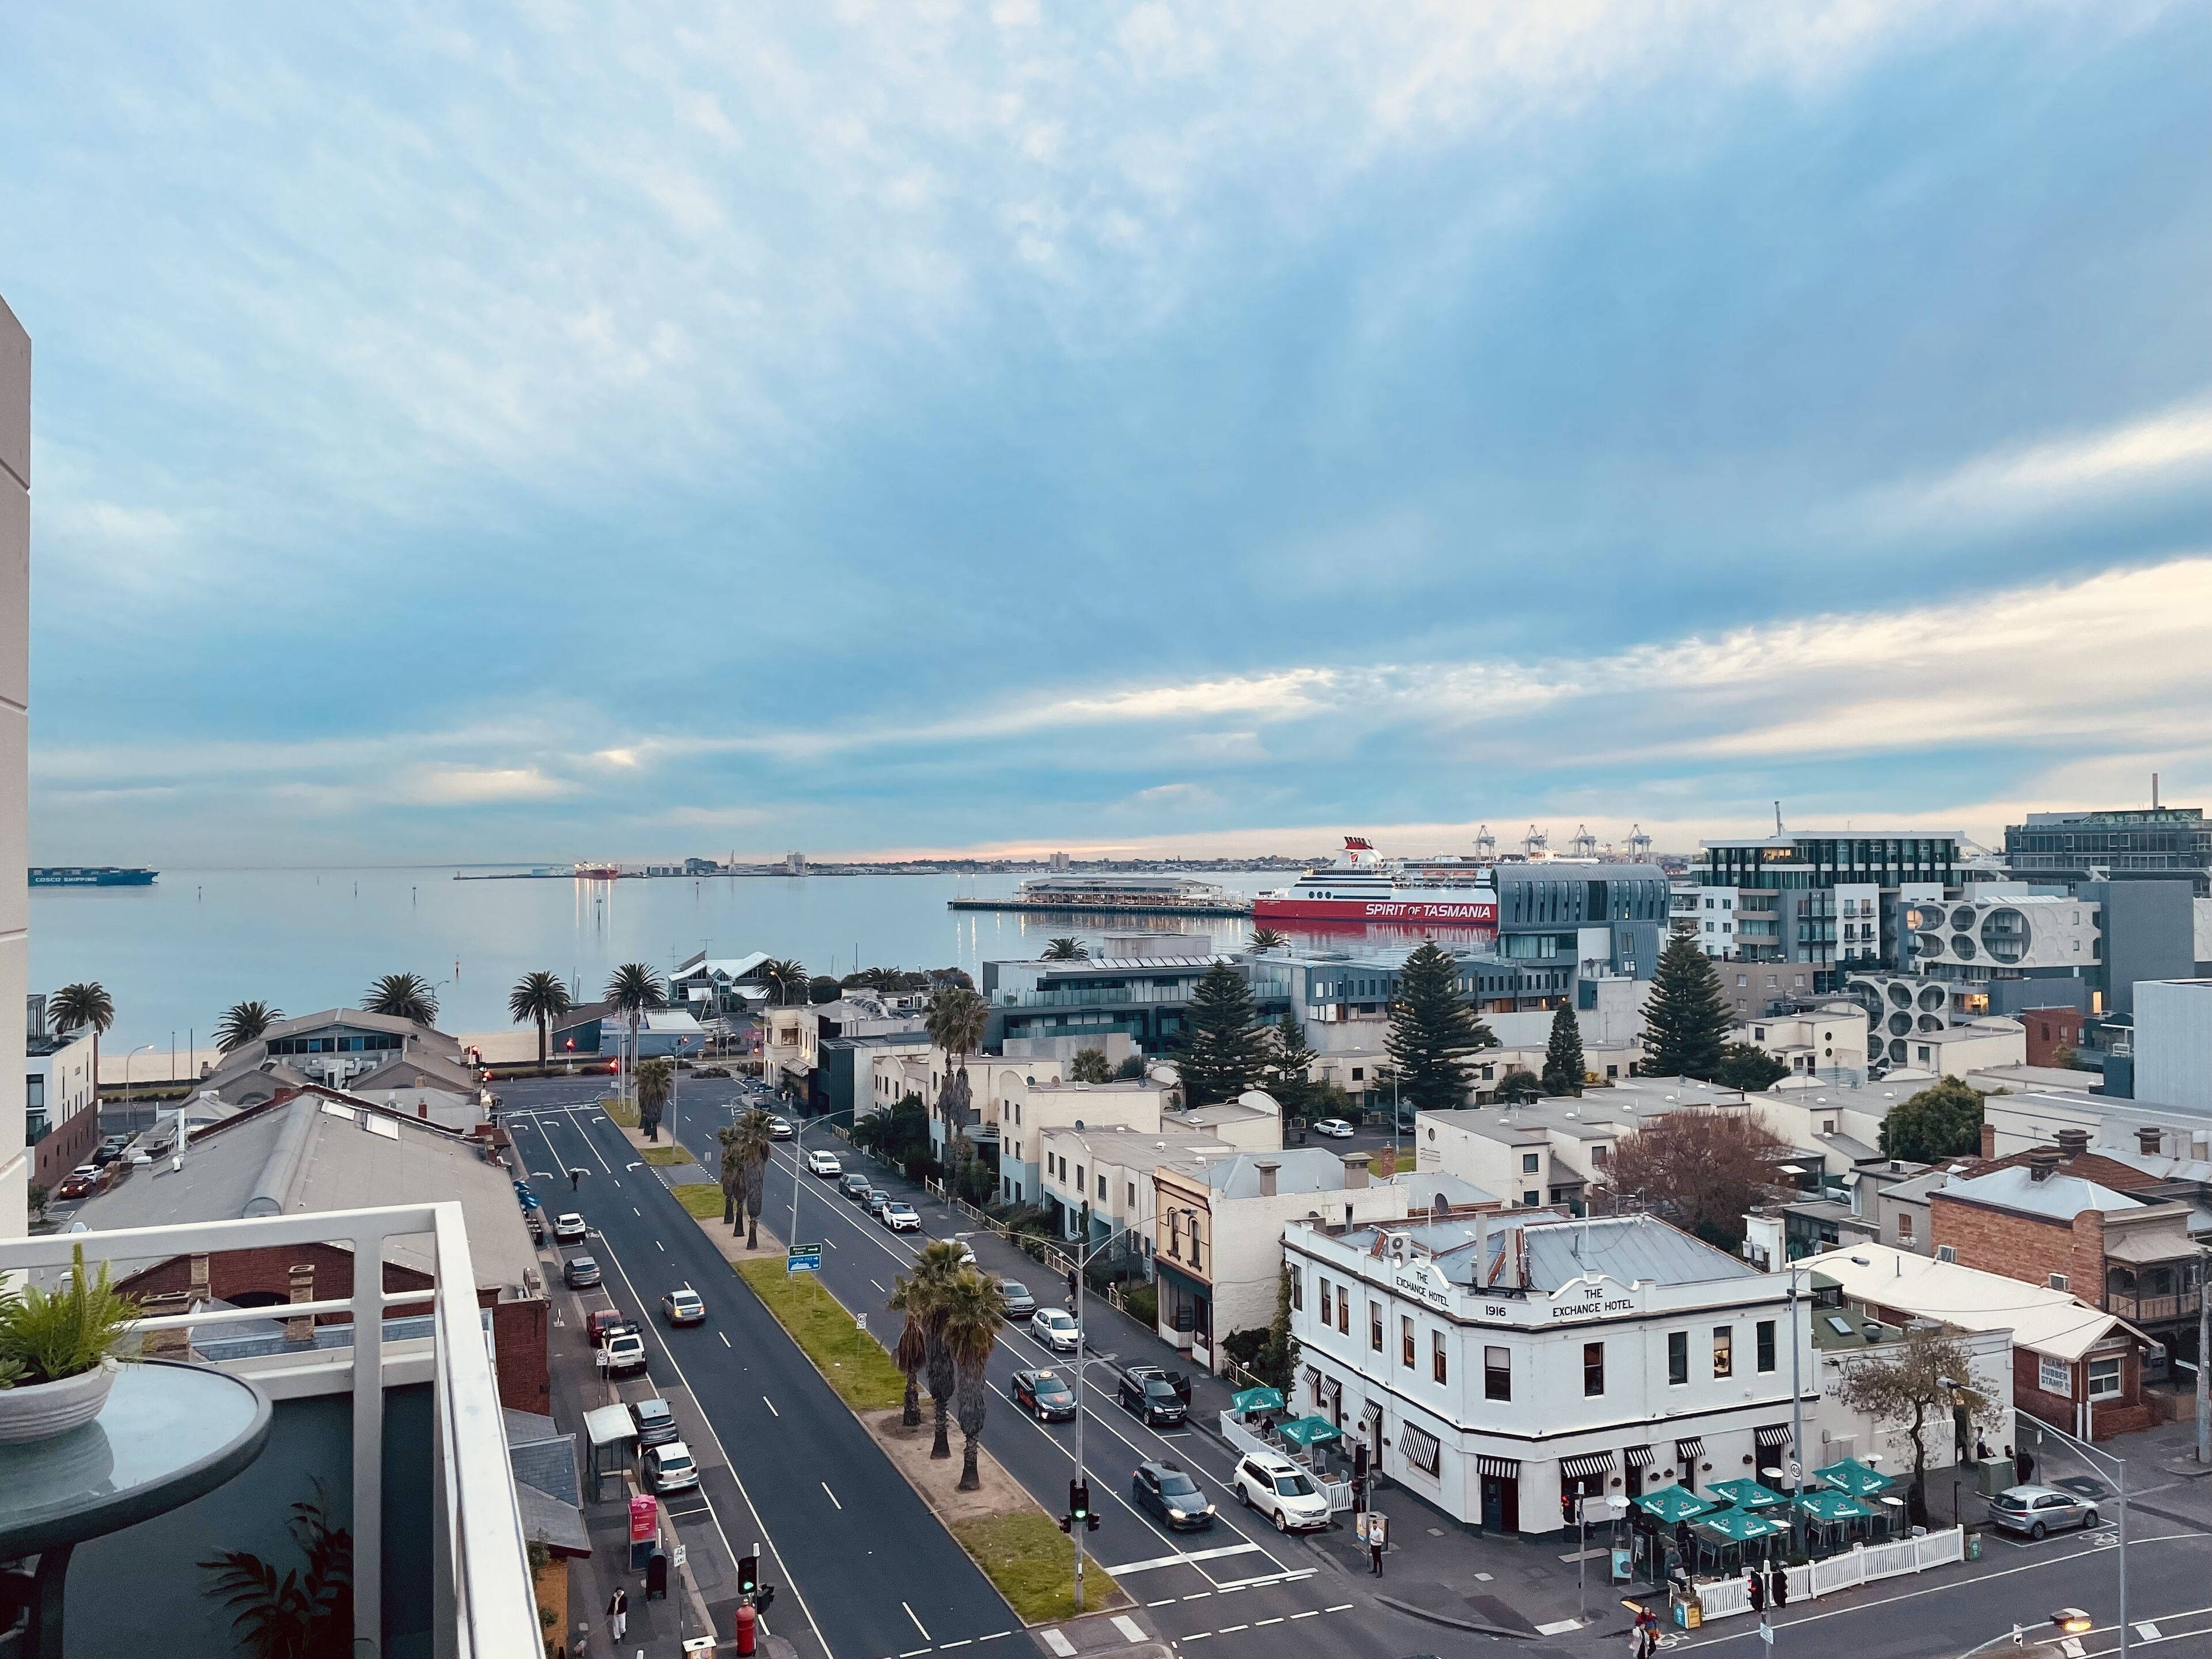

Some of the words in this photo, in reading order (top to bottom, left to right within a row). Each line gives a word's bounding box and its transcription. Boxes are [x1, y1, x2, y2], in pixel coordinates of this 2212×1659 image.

[1365, 904, 1407, 915] SPIRIT
[1408, 906, 1422, 915] OF
[1423, 905, 1491, 918] TASMANIA
[1416, 1271, 1428, 1284] THE
[1429, 1290, 1449, 1307] HOTEL
[1585, 1288, 1603, 1299] THE
[1486, 1305, 1506, 1316] 1916
[1605, 1299, 1634, 1311] HOTEL
[2043, 1357, 2067, 1372] ADAMS
[2041, 1366, 2068, 1381] RUBBER
[1310, 1431, 1333, 1440] Heineken
[1792, 1467, 1800, 1475] 40
